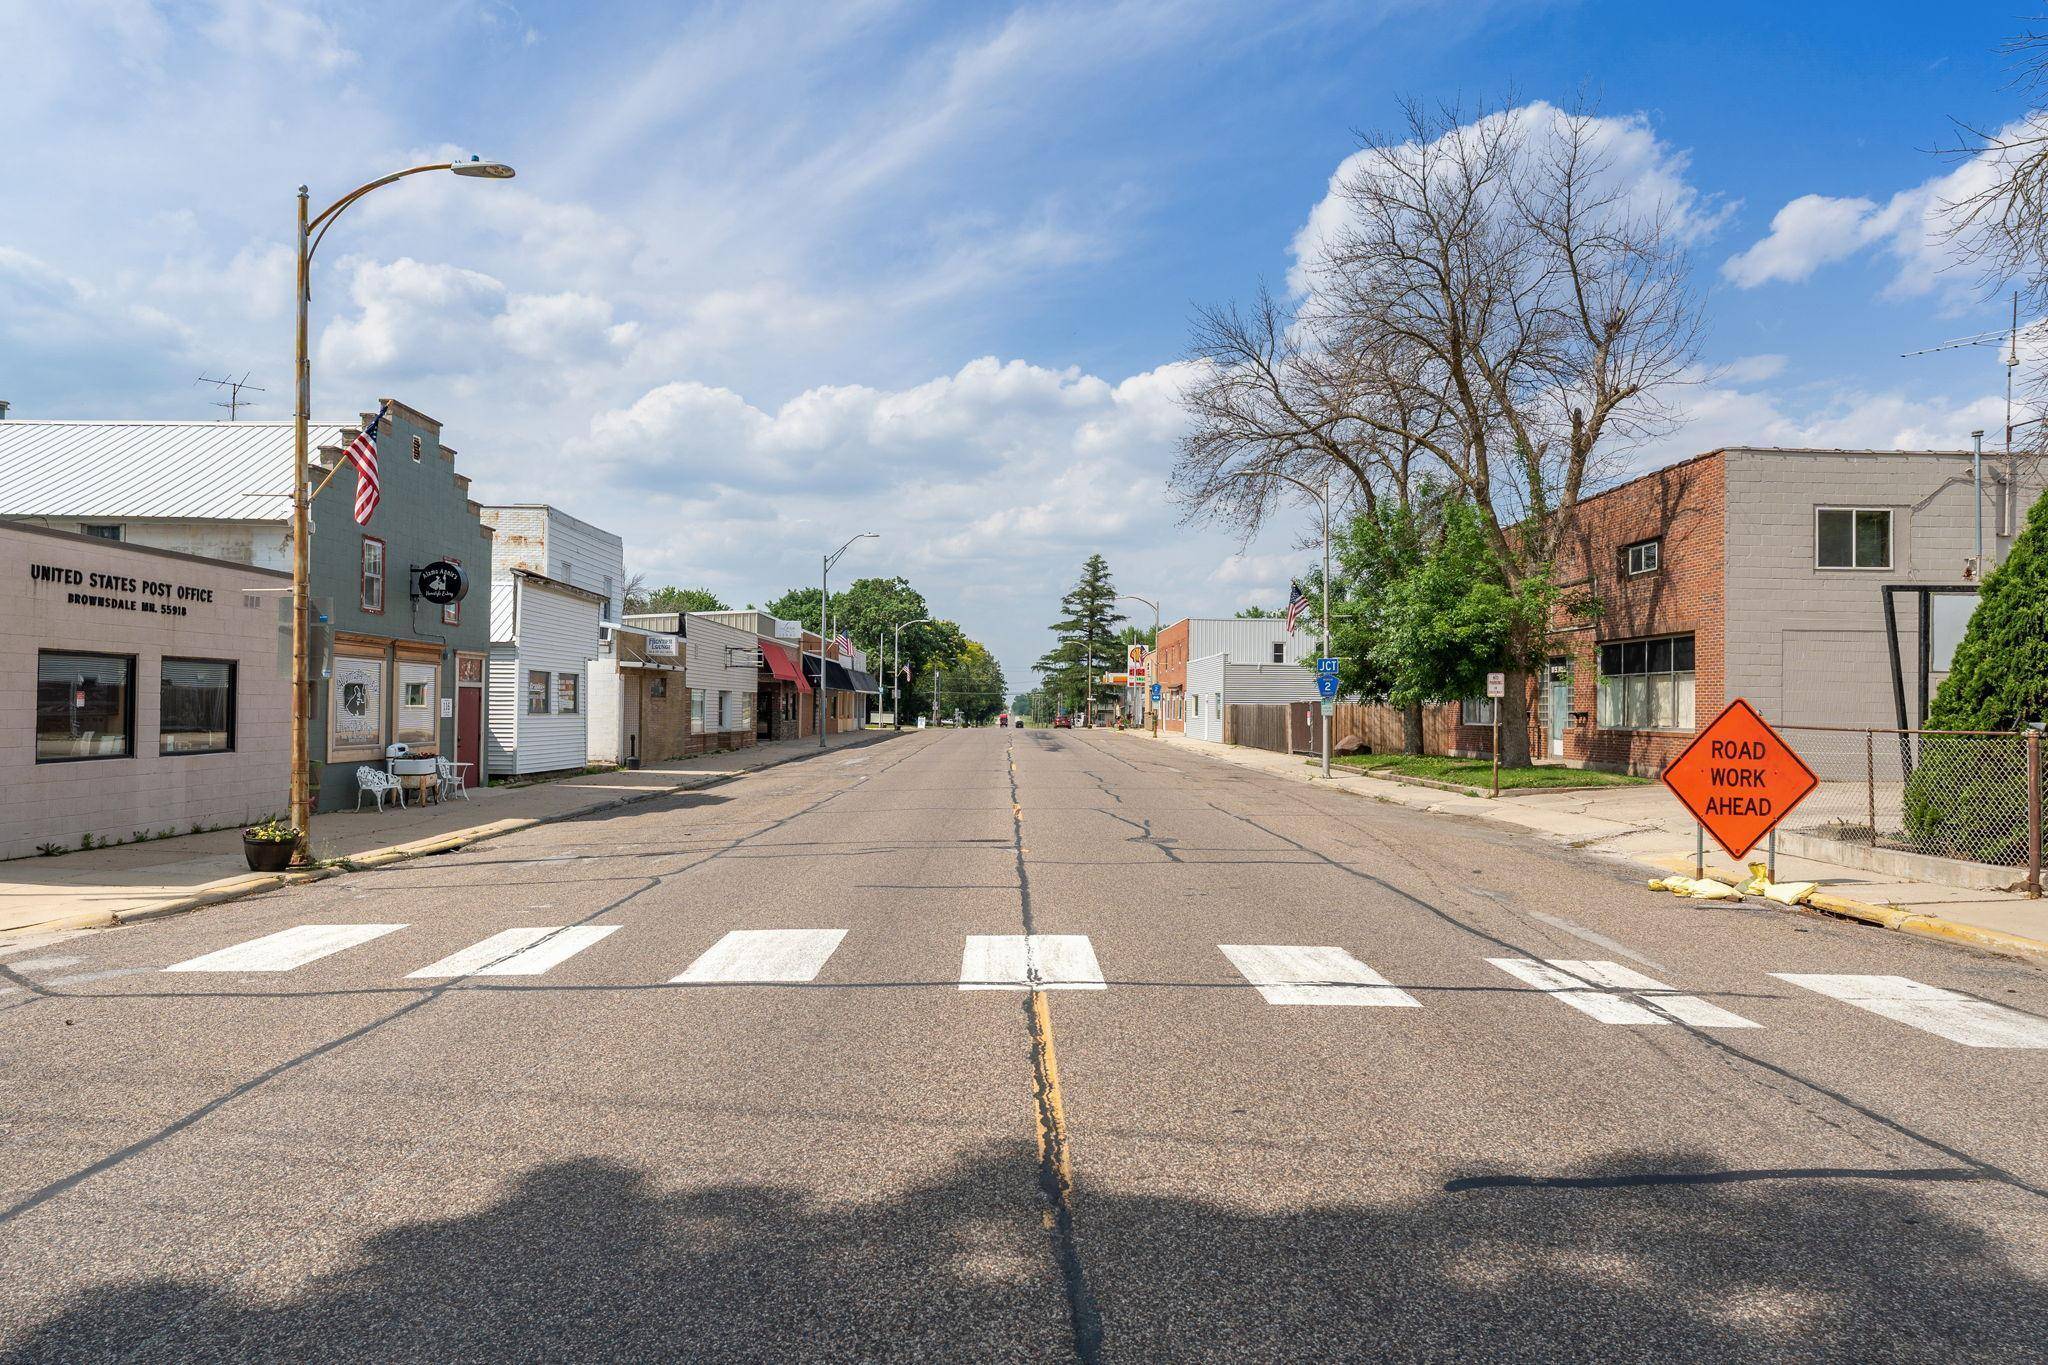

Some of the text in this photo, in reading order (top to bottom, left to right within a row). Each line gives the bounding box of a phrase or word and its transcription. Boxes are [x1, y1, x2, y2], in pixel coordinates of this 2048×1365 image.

[31, 564, 213, 603] UNITED STATES POST OFFICE
[68, 593, 136, 611] BROWNSDALE
[161, 606, 187, 616] 55918
[1319, 661, 1337, 671] JCT
[1324, 682, 1331, 691] 2
[1711, 740, 1766, 760] ROAD
[1711, 768, 1766, 788] WORK
[1705, 797, 1772, 816] AHEAD
